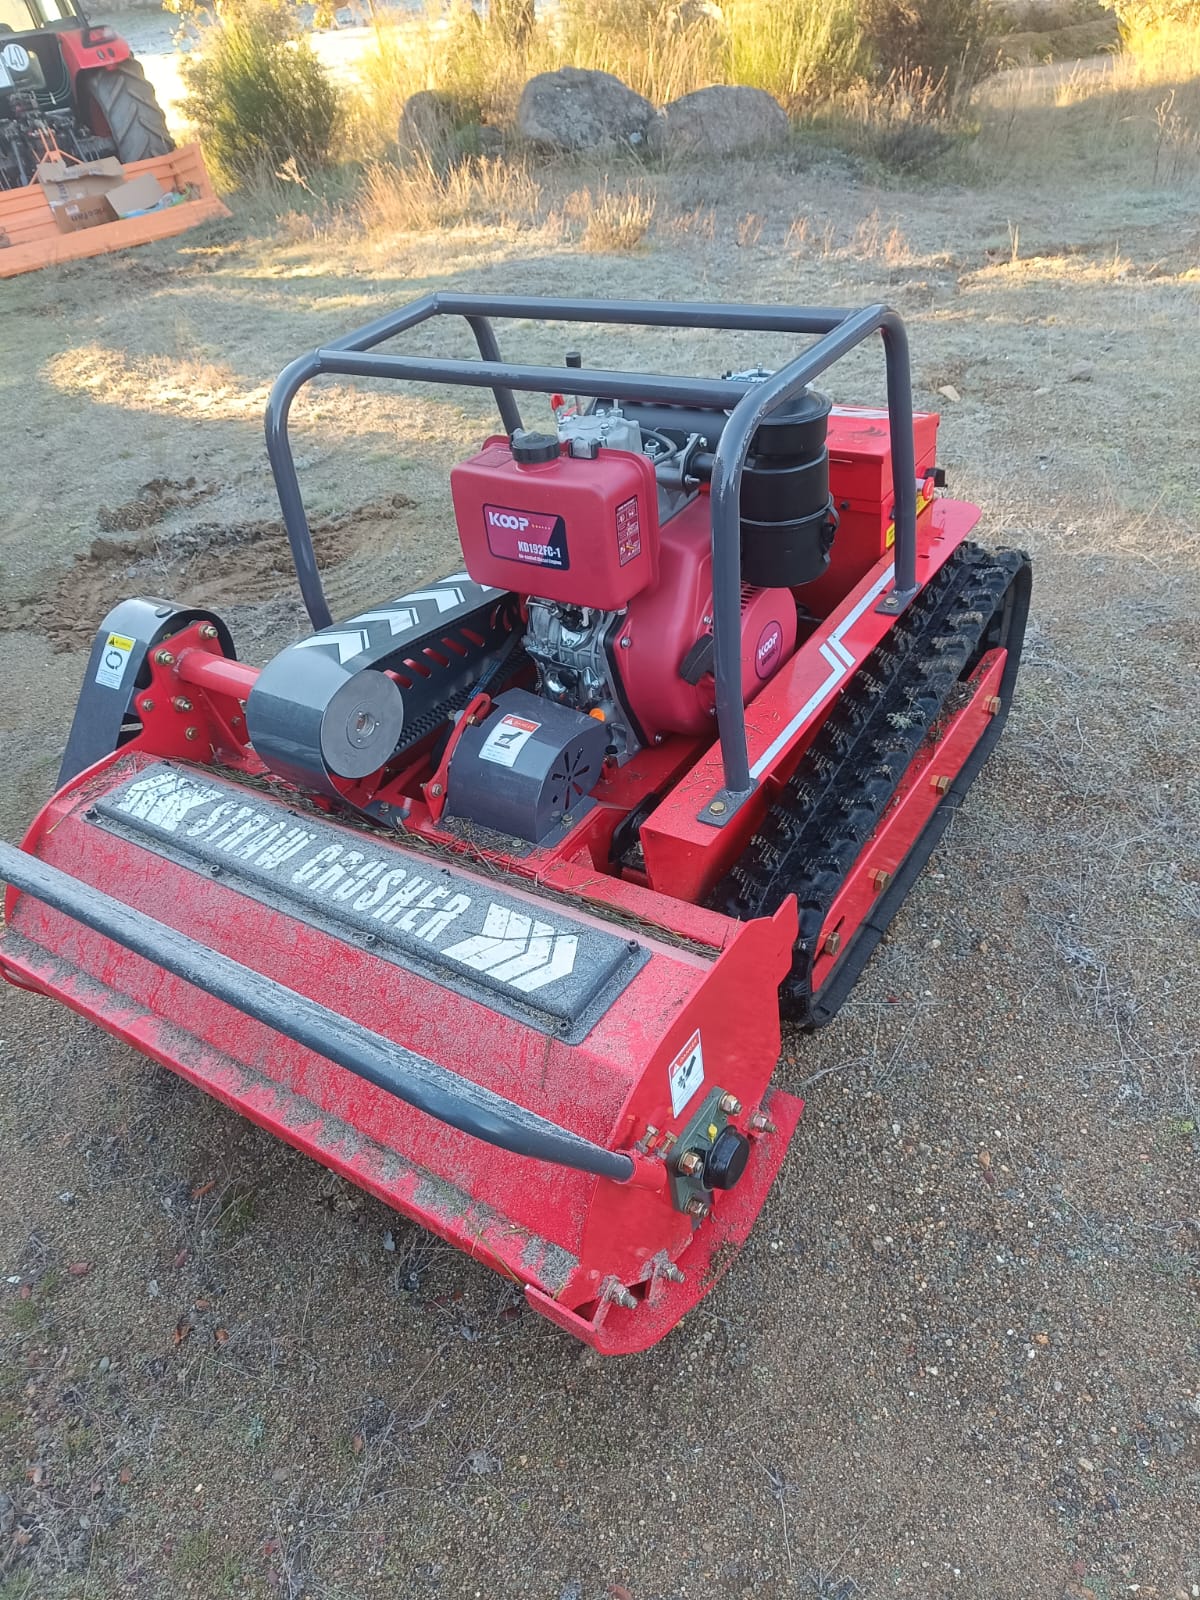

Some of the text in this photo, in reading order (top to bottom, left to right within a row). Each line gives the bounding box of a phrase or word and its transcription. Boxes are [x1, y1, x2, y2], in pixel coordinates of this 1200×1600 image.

[488, 511, 530, 531] KOOP
[517, 540, 562, 558] KD192FC-1
[758, 631, 778, 660] KOOP
[186, 801, 472, 943] STRAW CRUSHER
